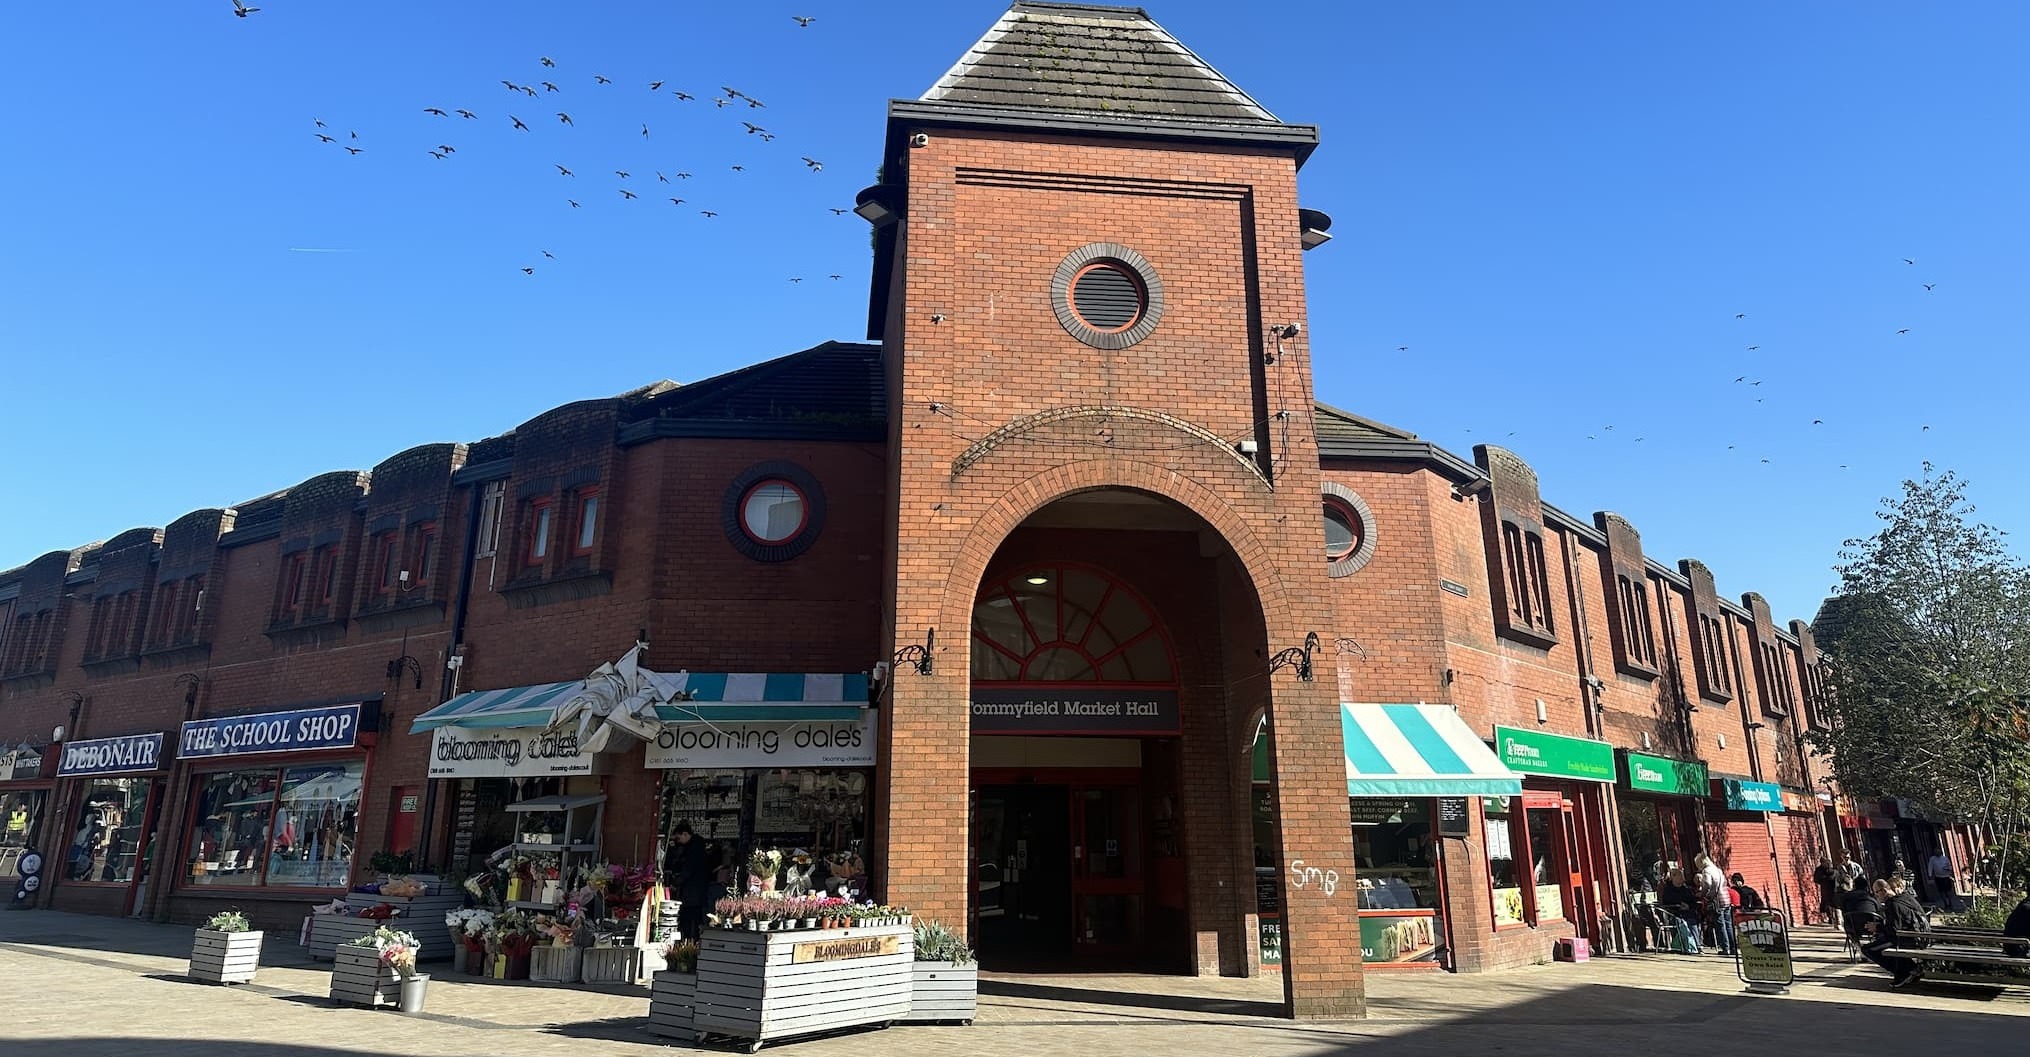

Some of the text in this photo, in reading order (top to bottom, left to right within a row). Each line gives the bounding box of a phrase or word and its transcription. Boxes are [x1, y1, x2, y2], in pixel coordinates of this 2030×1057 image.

[1064, 701, 1121, 716] Market
[1126, 701, 1159, 716] Hall
[185, 714, 351, 750] THE SCHOOL SHOP
[657, 725, 779, 754] blooming
[64, 741, 155, 770] DEBONAIR
[1739, 920, 1780, 933] SALAD
[1750, 934, 1774, 945] BAR
